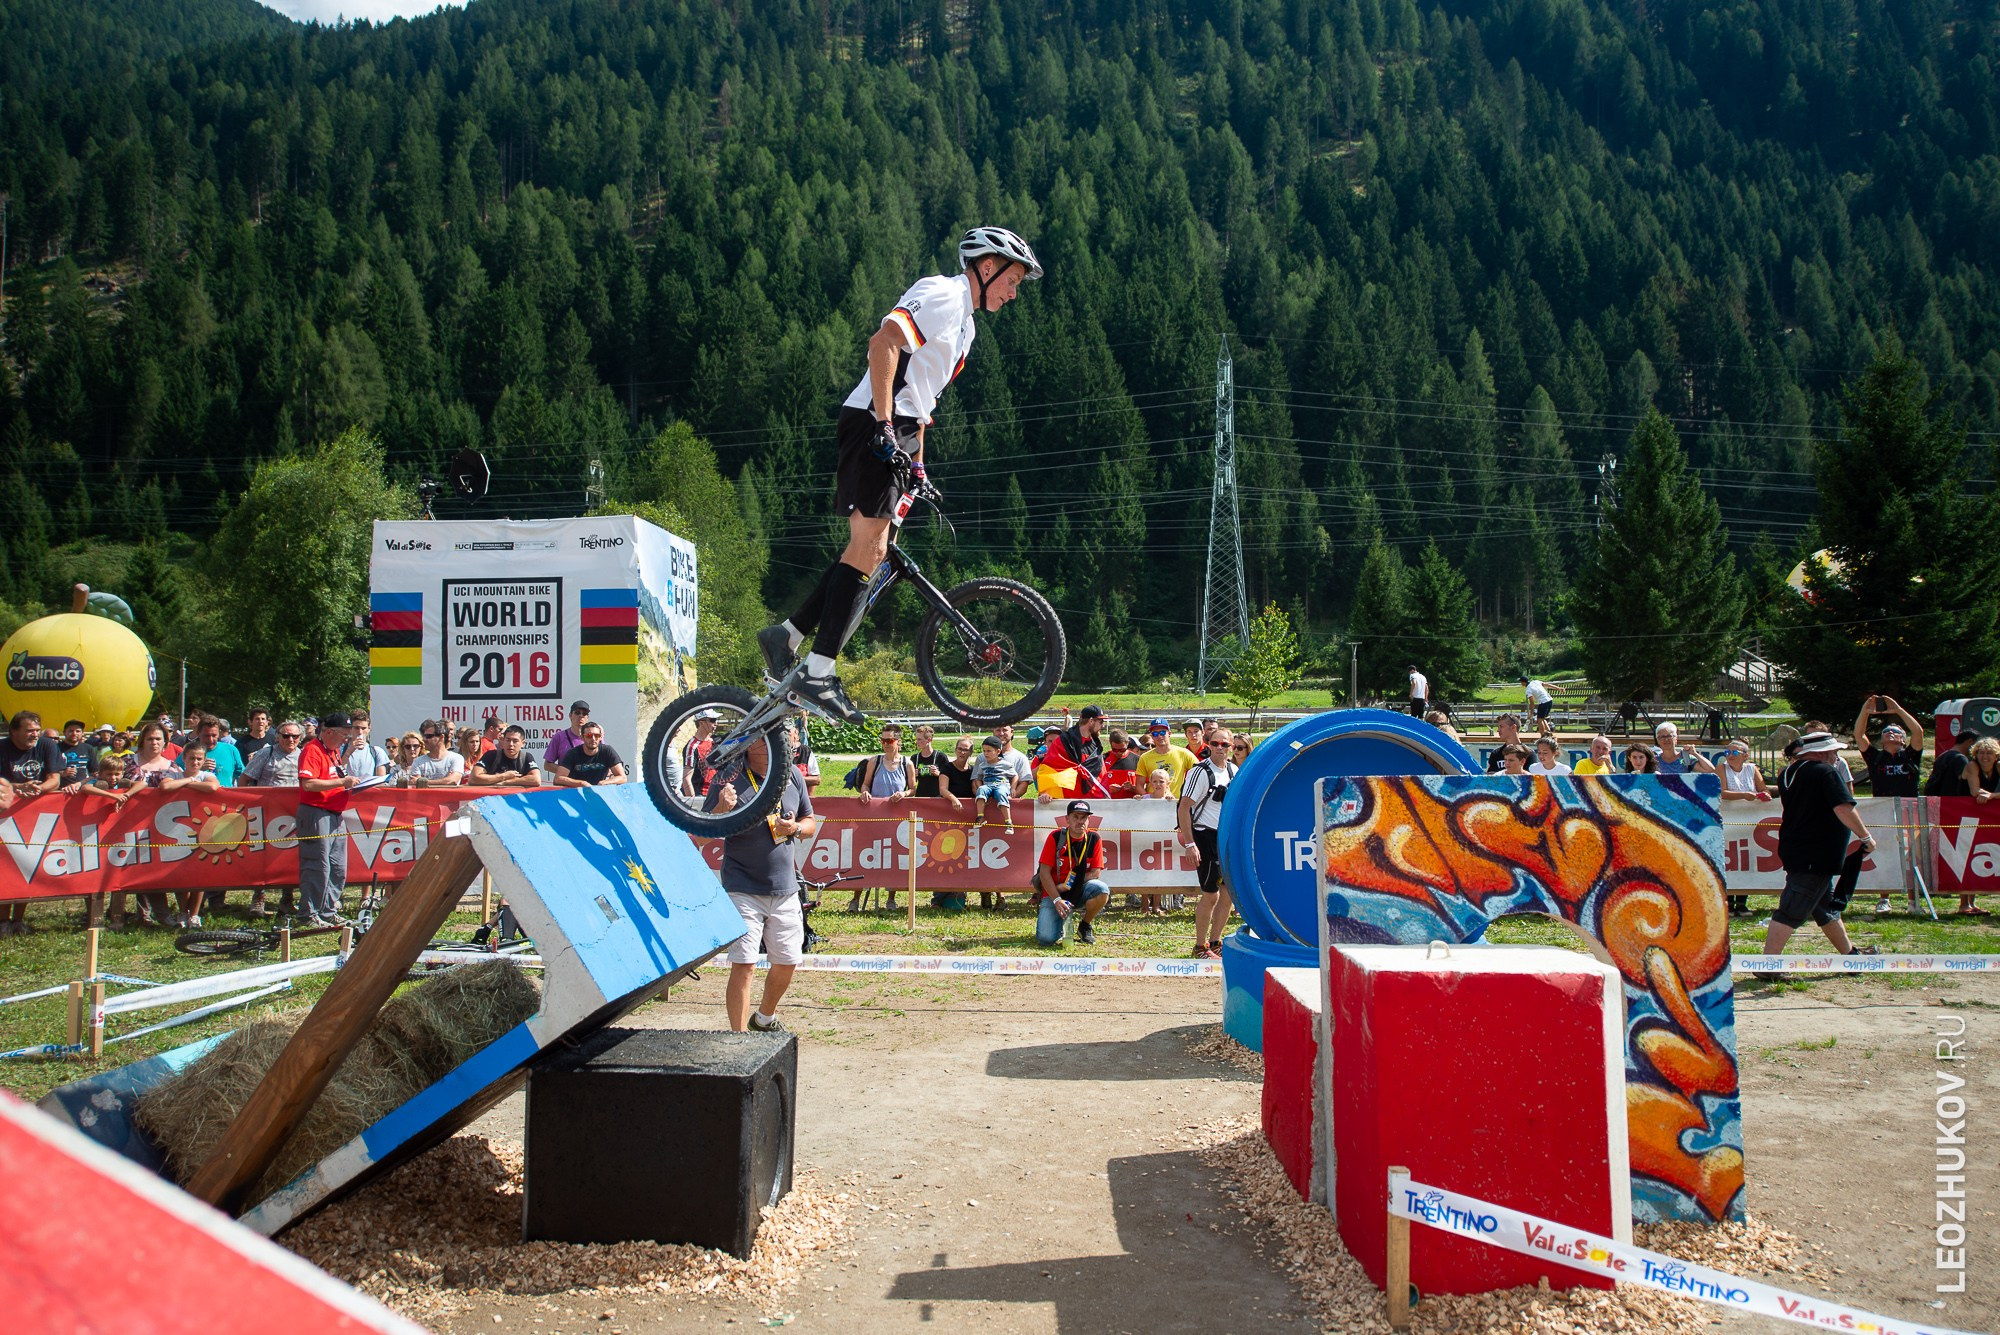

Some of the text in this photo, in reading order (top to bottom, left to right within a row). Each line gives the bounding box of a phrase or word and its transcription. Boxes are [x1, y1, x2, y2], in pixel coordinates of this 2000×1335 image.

[385, 539, 400, 550] Val
[409, 540, 431, 550] Sole
[579, 537, 624, 549] TRENTINO
[670, 545, 695, 583] BIKE
[454, 585, 551, 596] UCI MOUNTAIN BIKE
[674, 584, 695, 619] FUN
[453, 601, 551, 628] WORLD
[455, 633, 549, 646] CHAMPIONSHIPS
[8, 663, 80, 681] Melinda
[459, 651, 550, 689] 2016
[441, 704, 564, 722] DHI 4X TRIALS
[525, 728, 539, 739] ND
[0, 800, 299, 884] Val di Sole
[342, 806, 429, 870] Val
[859, 837, 892, 870] di
[896, 816, 1011, 871] Sole
[1930, 816, 2000, 884] Va
[1139, 839, 1173, 871] di
[1404, 1189, 1498, 1234] TRENTINO
[1523, 1221, 1627, 1272] Val di Sole
[1641, 1258, 1750, 1304] TRENTINO
[1777, 1295, 1816, 1322] Val
[1820, 1315, 1836, 1325] di
